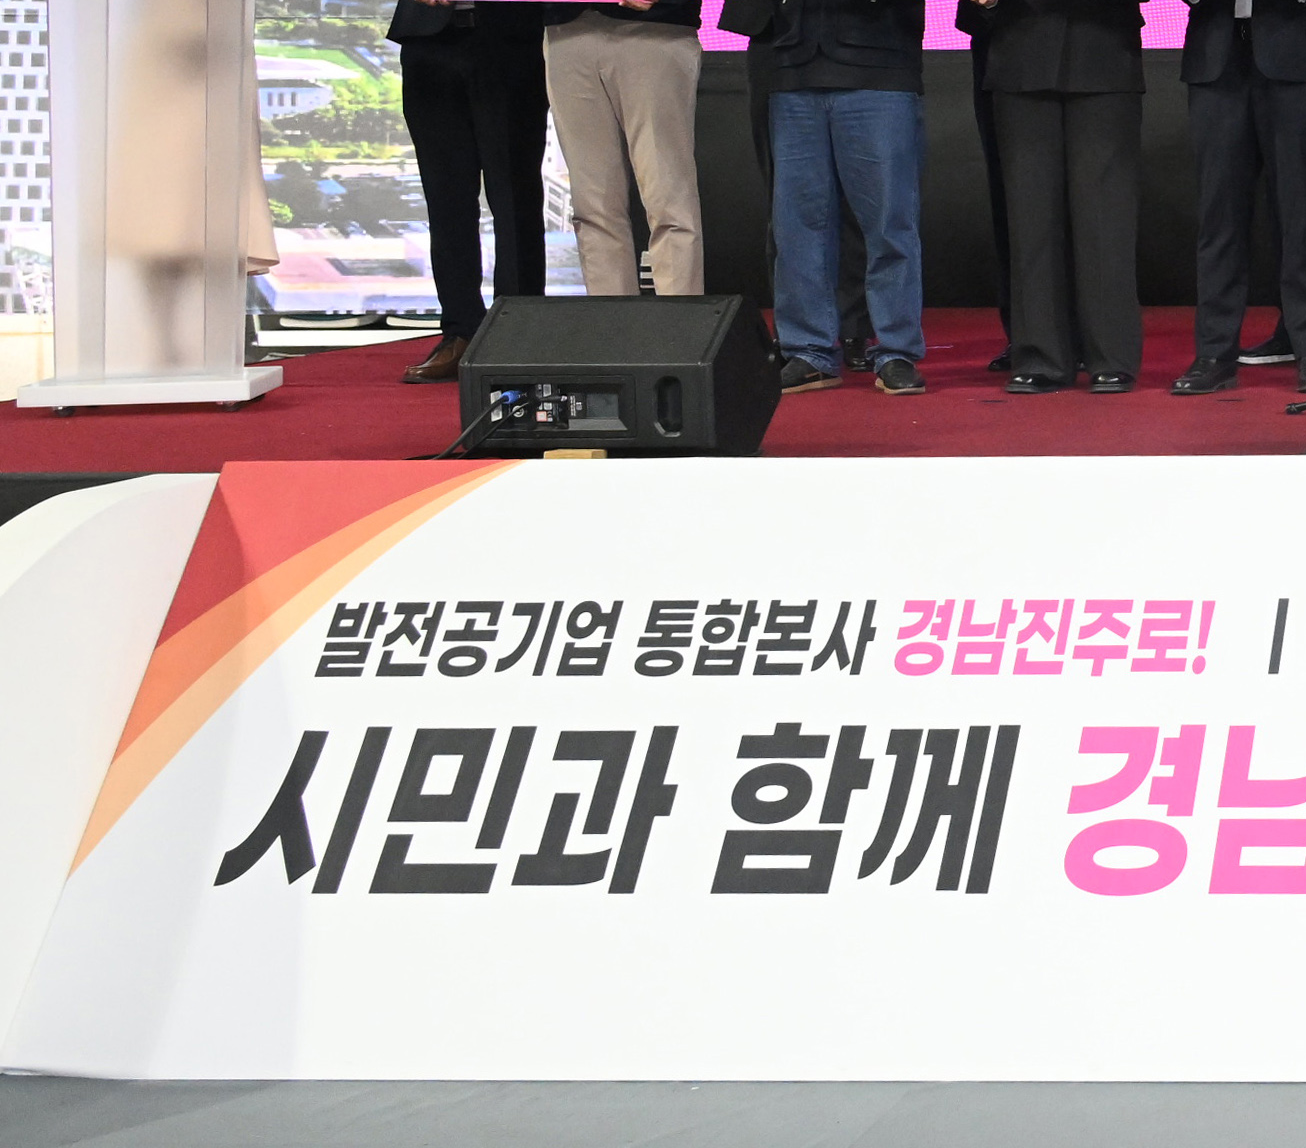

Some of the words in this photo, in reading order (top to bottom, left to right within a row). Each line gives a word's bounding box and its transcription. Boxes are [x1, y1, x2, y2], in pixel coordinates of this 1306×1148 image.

[315, 599, 625, 678] 발전공기업
[634, 598, 877, 678] 통합본사
[894, 598, 1216, 677] 경남진주로!
[213, 725, 680, 895] 시민과
[709, 721, 1022, 895] 함께
